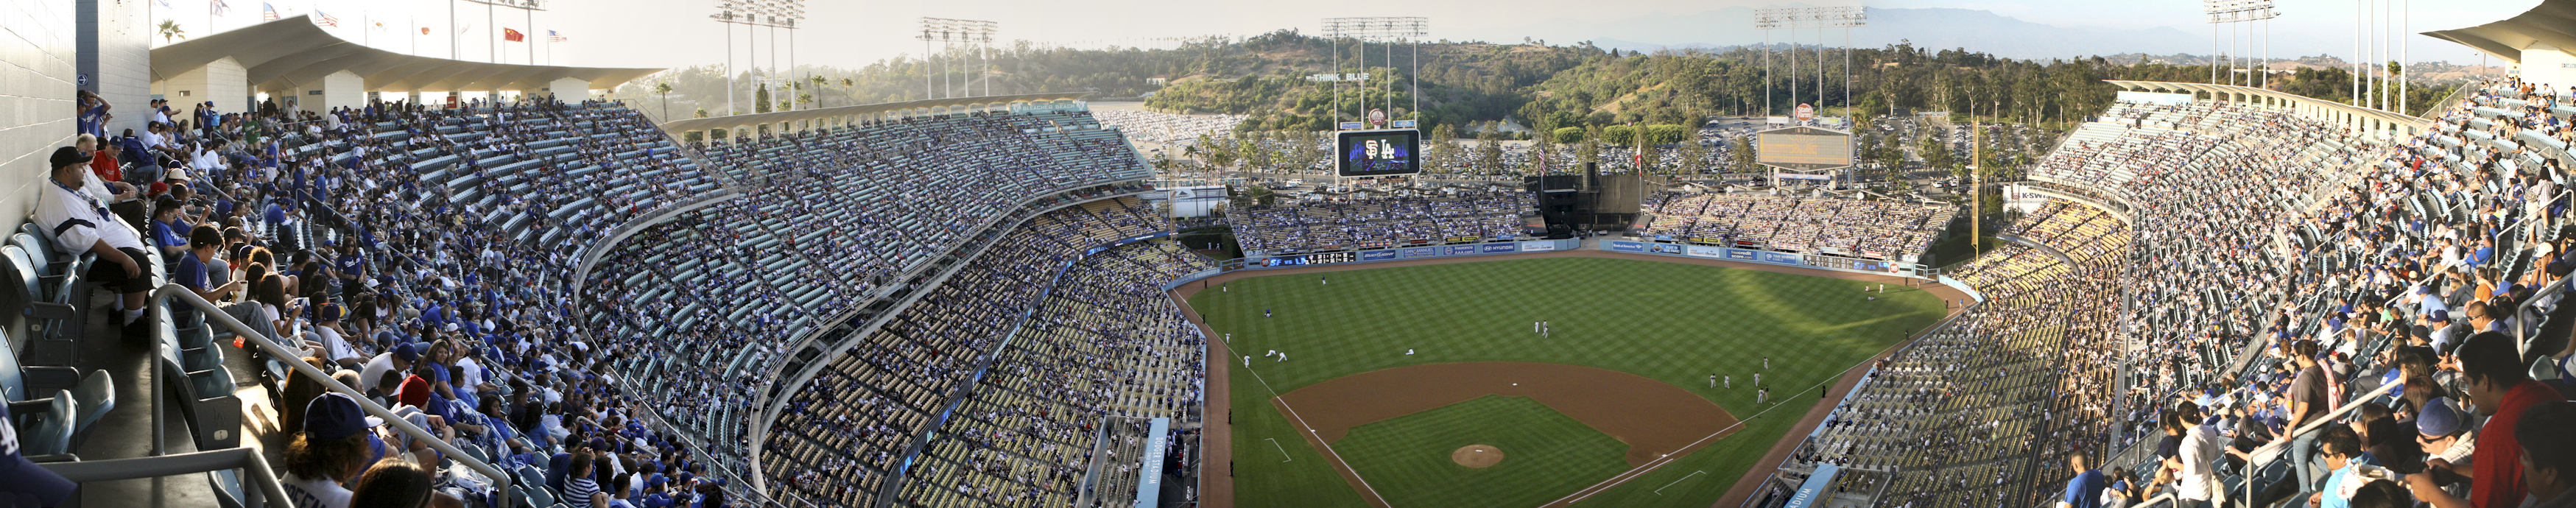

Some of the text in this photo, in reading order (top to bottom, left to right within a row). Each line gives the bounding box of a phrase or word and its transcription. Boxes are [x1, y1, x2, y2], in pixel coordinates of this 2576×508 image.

[1365, 140, 1379, 159] SF
[1381, 139, 1395, 159] LA
[1149, 437, 1164, 484] DODGER STADIUM
